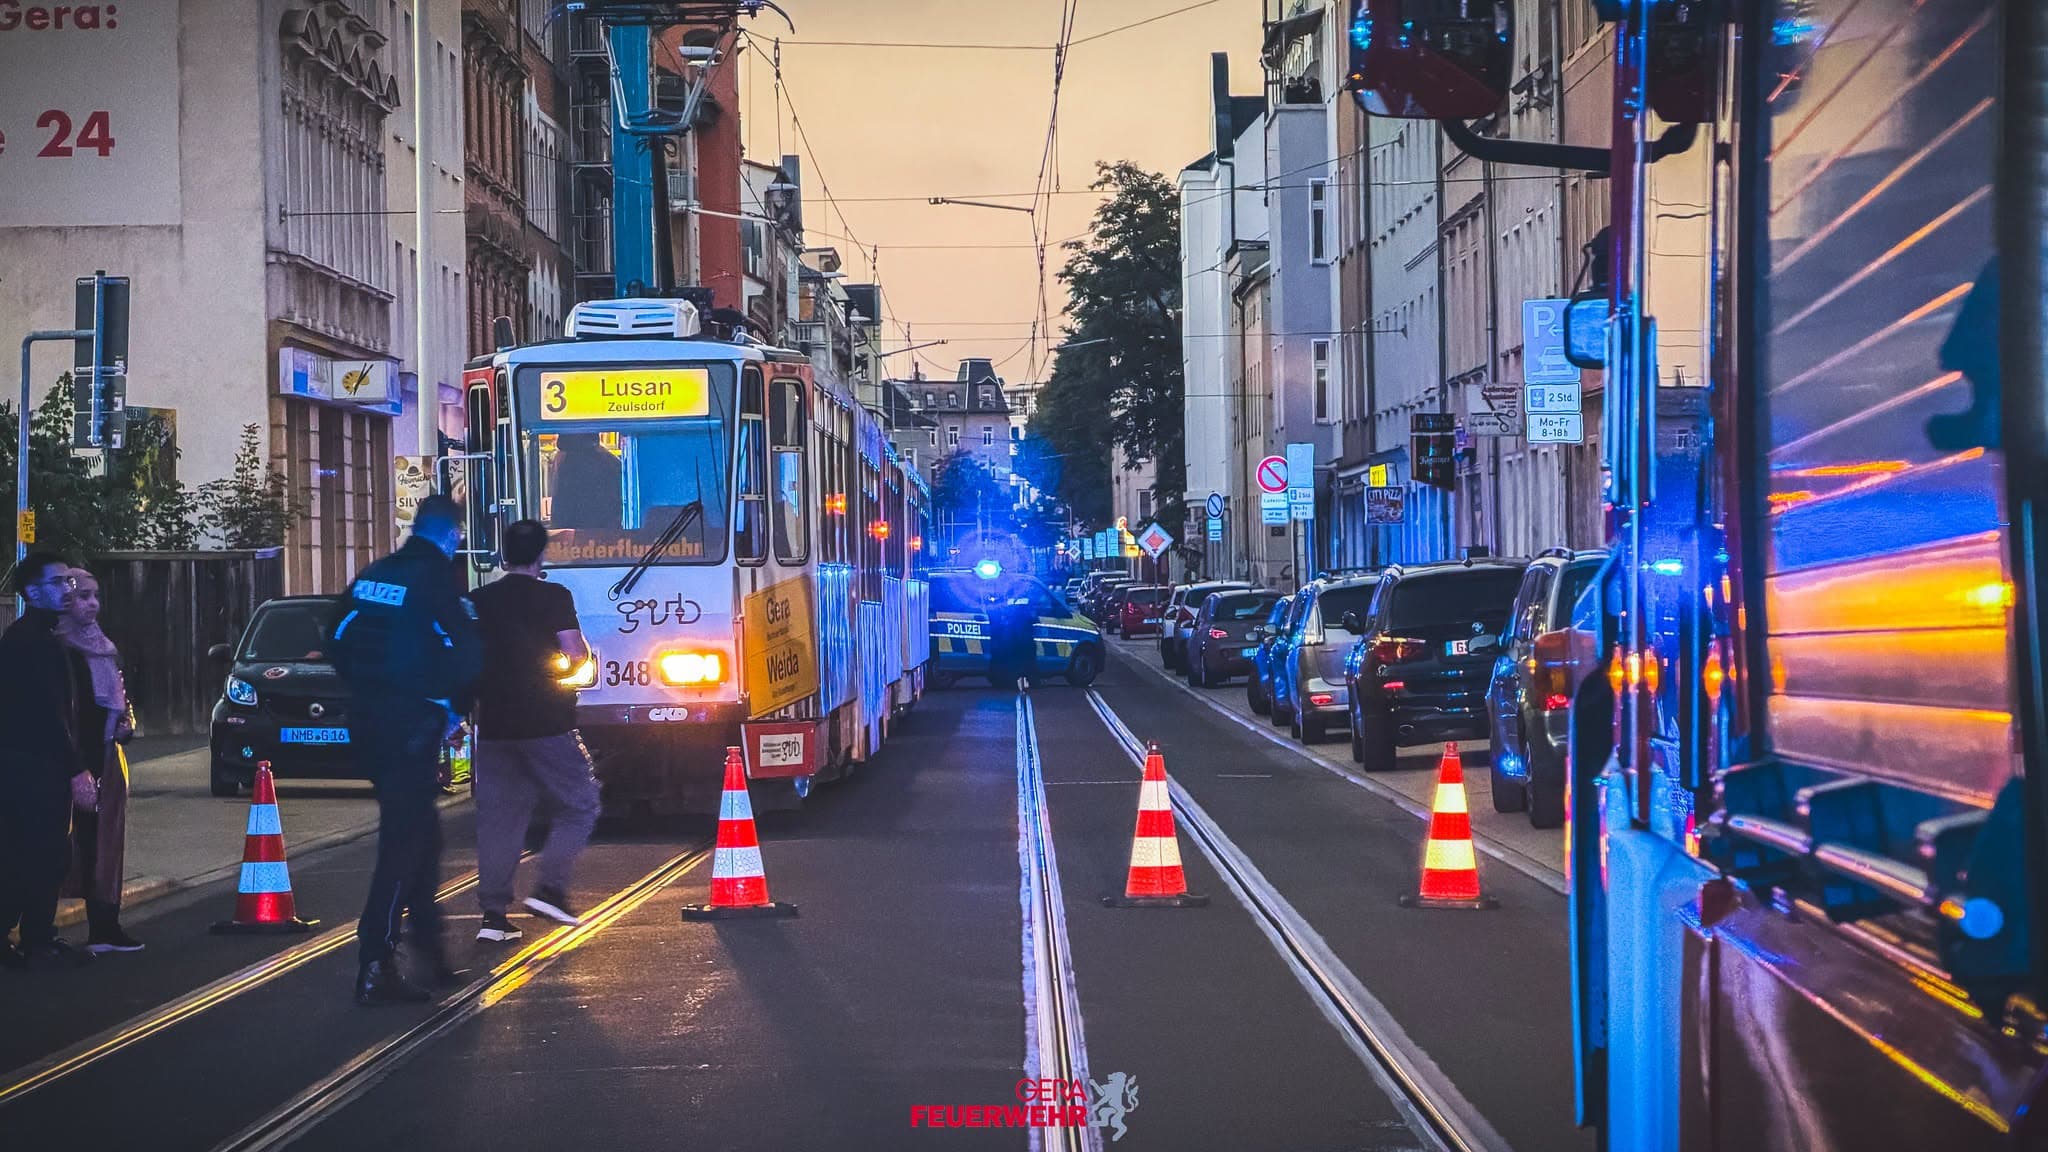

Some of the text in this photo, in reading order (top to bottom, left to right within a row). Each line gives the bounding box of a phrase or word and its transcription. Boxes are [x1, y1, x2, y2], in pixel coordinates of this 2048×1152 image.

[0, 0, 117, 31] Gera:
[36, 109, 115, 157] 24
[546, 379, 672, 413] 3 Lusan
[608, 401, 665, 412] Zeulsdorf
[1549, 393, 1555, 402] 2
[1540, 418, 1570, 427] Mo-Fr
[766, 598, 791, 625] Gera
[947, 623, 981, 635] POLIZEI
[606, 660, 651, 686] 348
[766, 647, 799, 684] Weida
